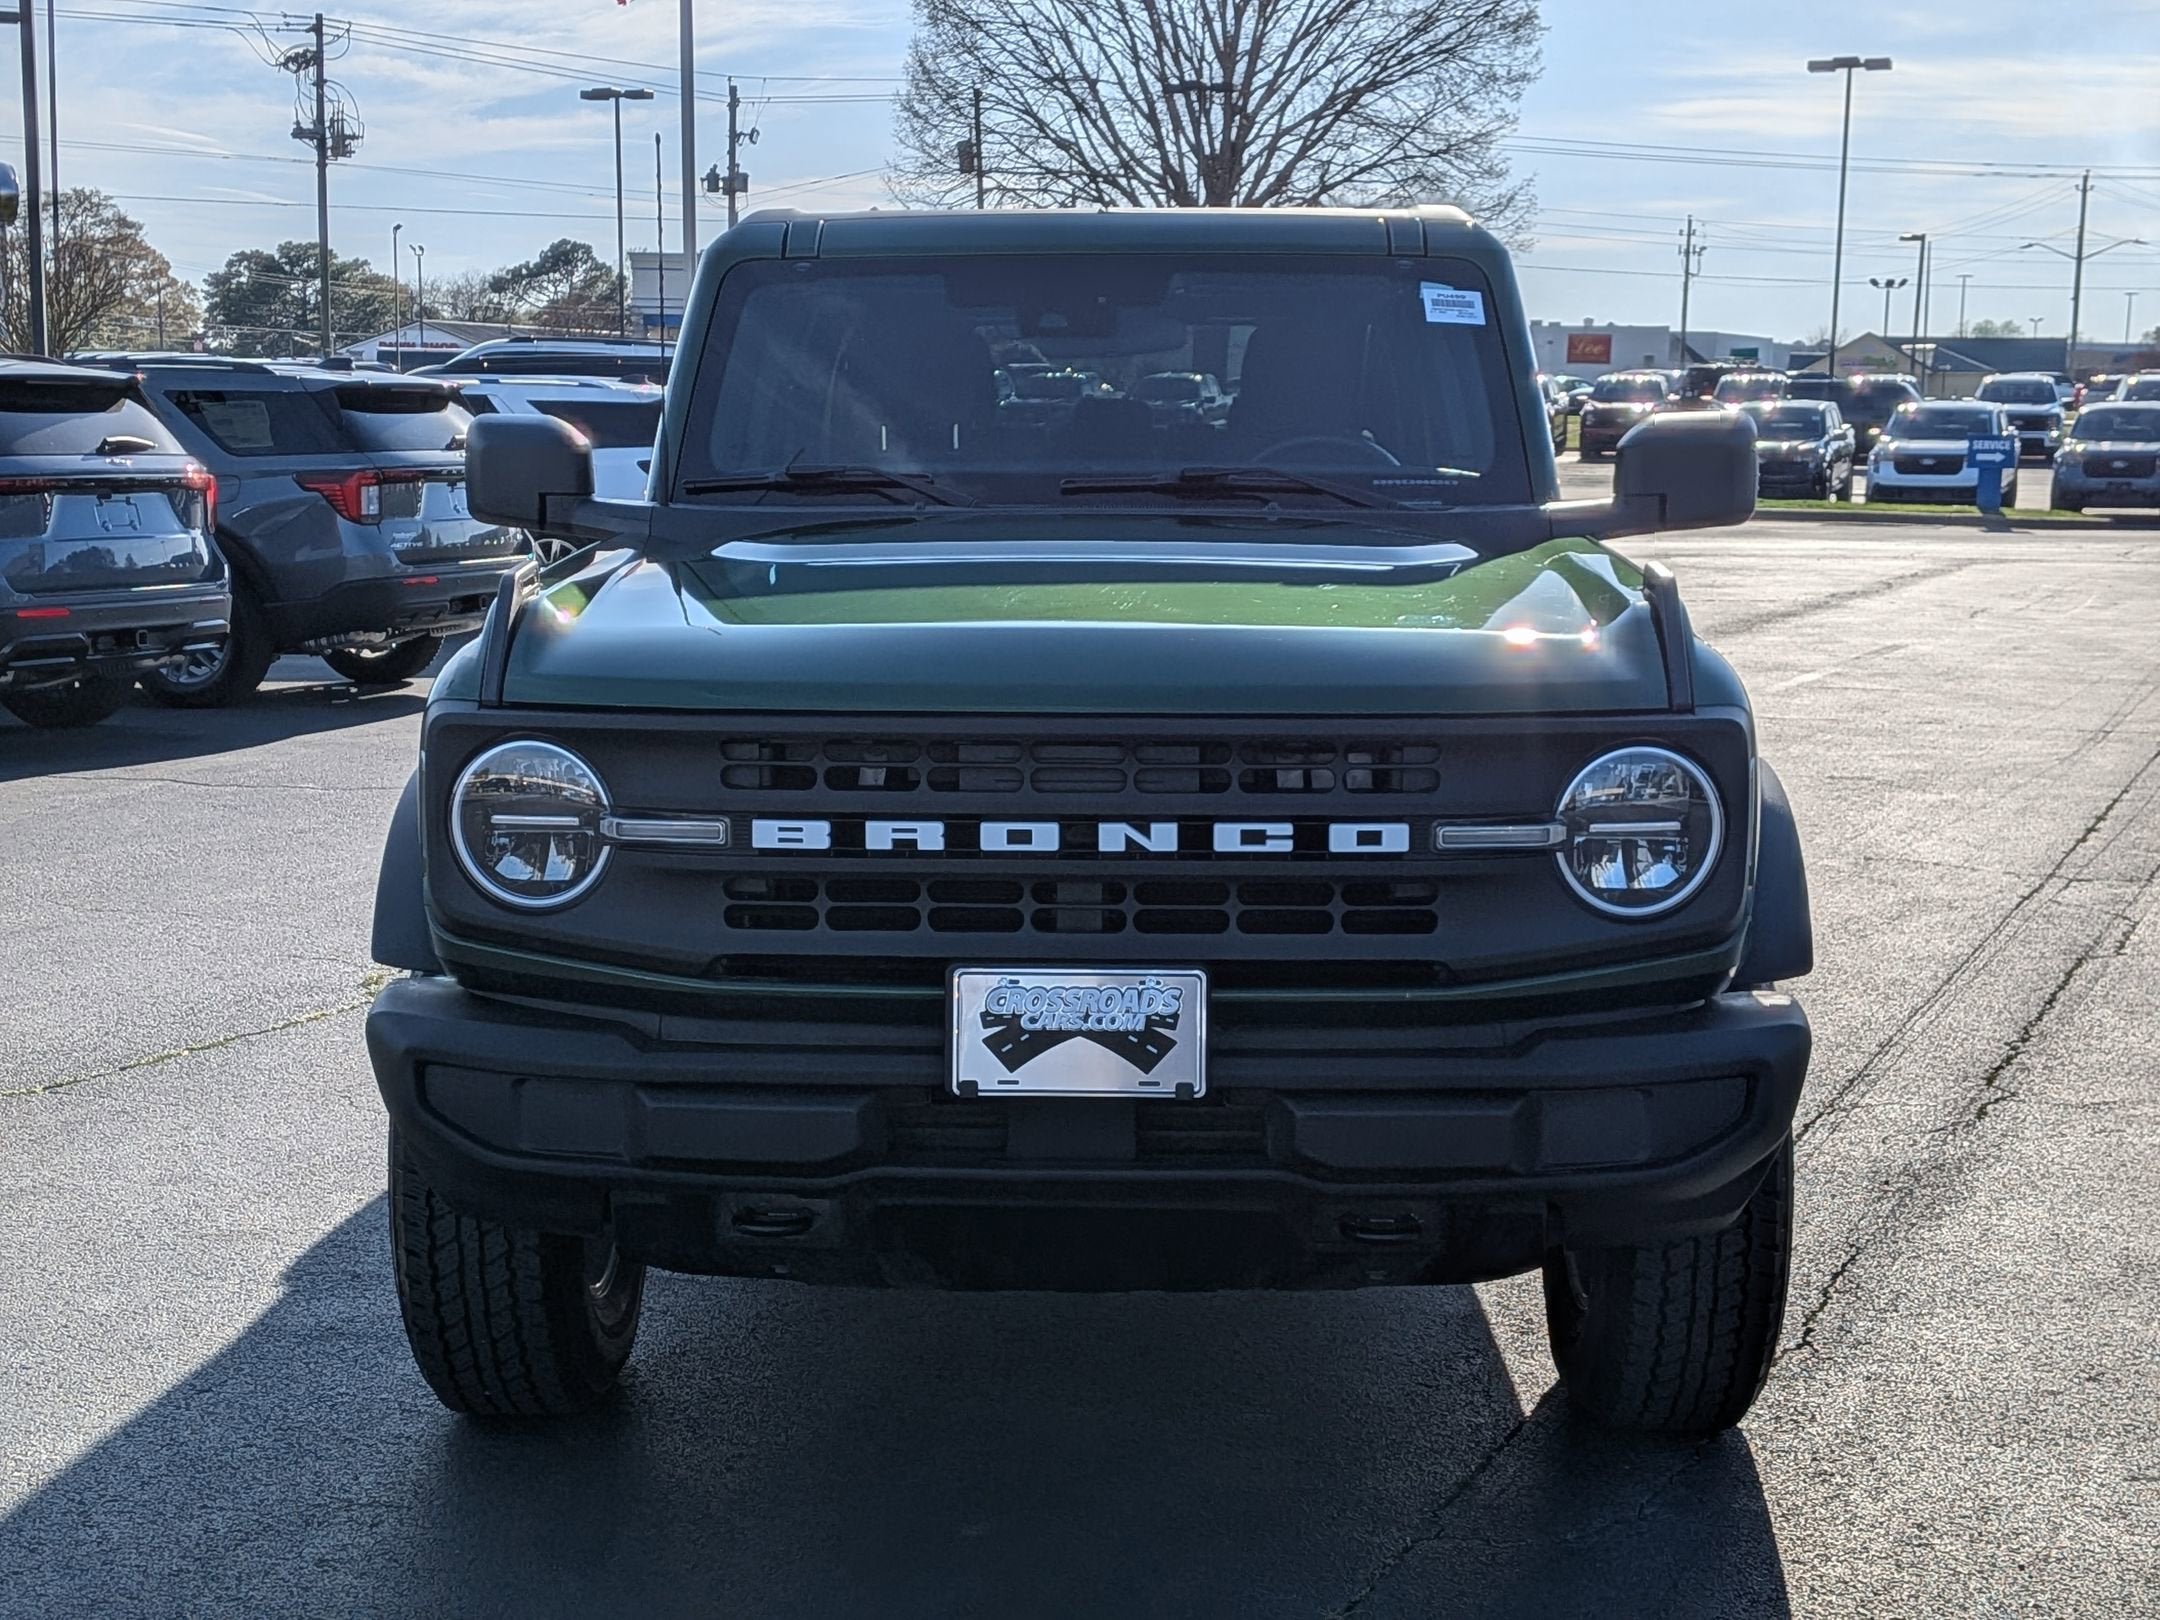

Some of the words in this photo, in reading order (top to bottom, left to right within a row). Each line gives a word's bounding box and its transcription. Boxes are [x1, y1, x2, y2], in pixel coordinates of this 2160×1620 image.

[1972, 440, 2011, 450] SERVICE
[752, 818, 1410, 853] BRONCO
[986, 985, 1183, 1014] CROSSROADS
[1020, 1013, 1146, 1032] CARS.COM
